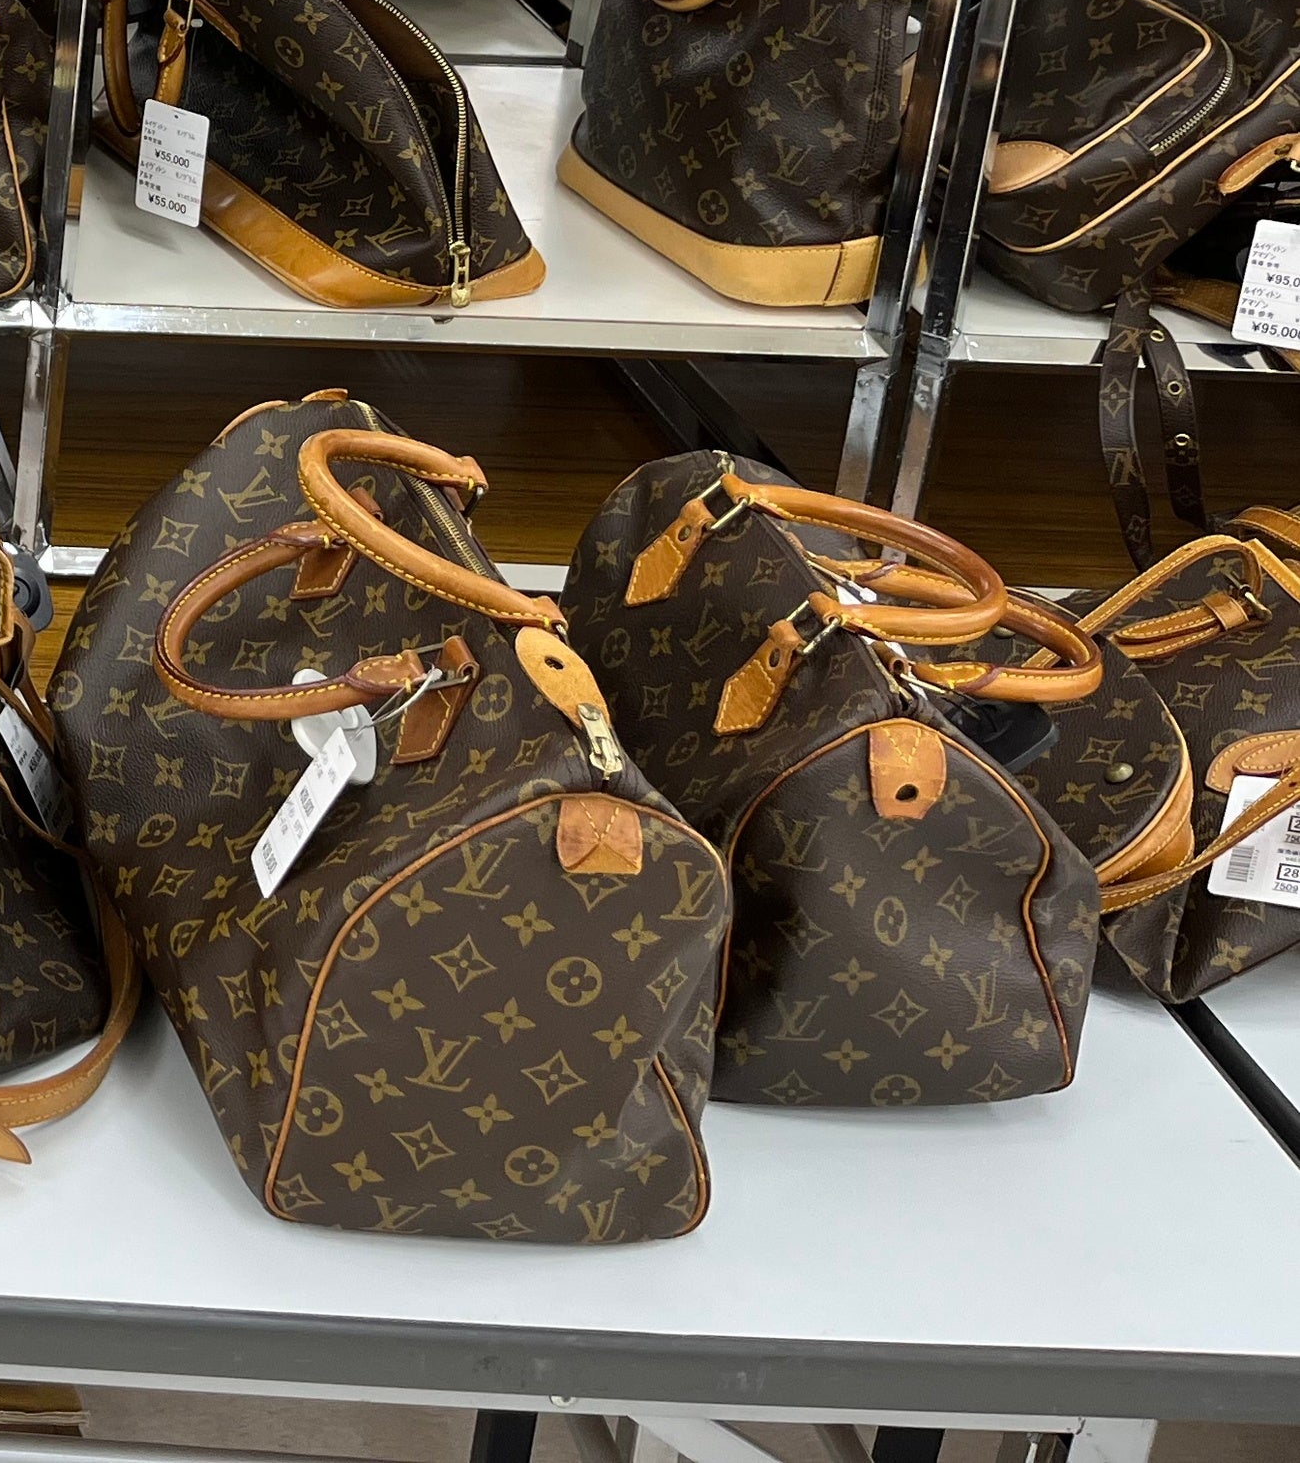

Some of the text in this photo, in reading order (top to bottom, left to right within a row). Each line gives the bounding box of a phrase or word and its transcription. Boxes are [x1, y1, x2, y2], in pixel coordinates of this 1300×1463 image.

[155, 148, 190, 169] ¥55,000
[148, 192, 187, 215] ¥55,000
[1283, 867, 1300, 880] 28
